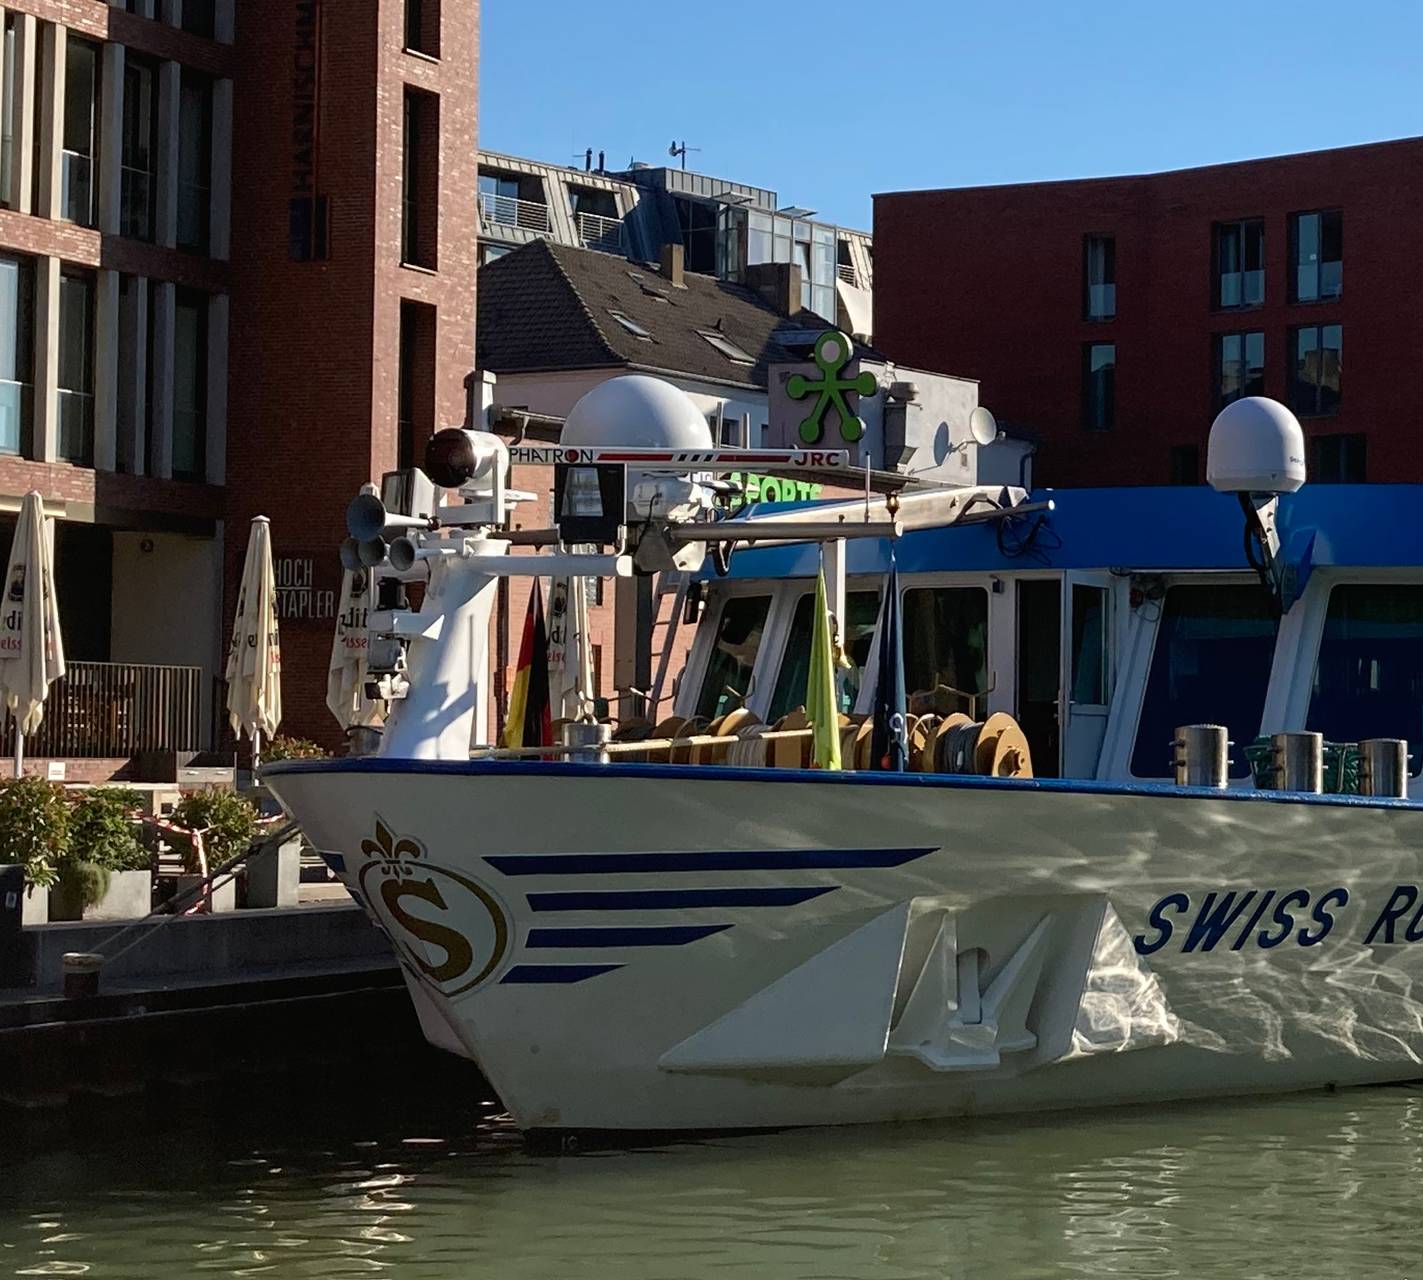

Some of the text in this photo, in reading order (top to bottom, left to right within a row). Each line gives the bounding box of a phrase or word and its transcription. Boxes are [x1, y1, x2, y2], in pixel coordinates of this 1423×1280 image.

[794, 452, 840, 467] JRC
[273, 558, 313, 586] HOCH
[276, 590, 334, 618] TAPLER
[1135, 888, 1350, 956] SWISS
